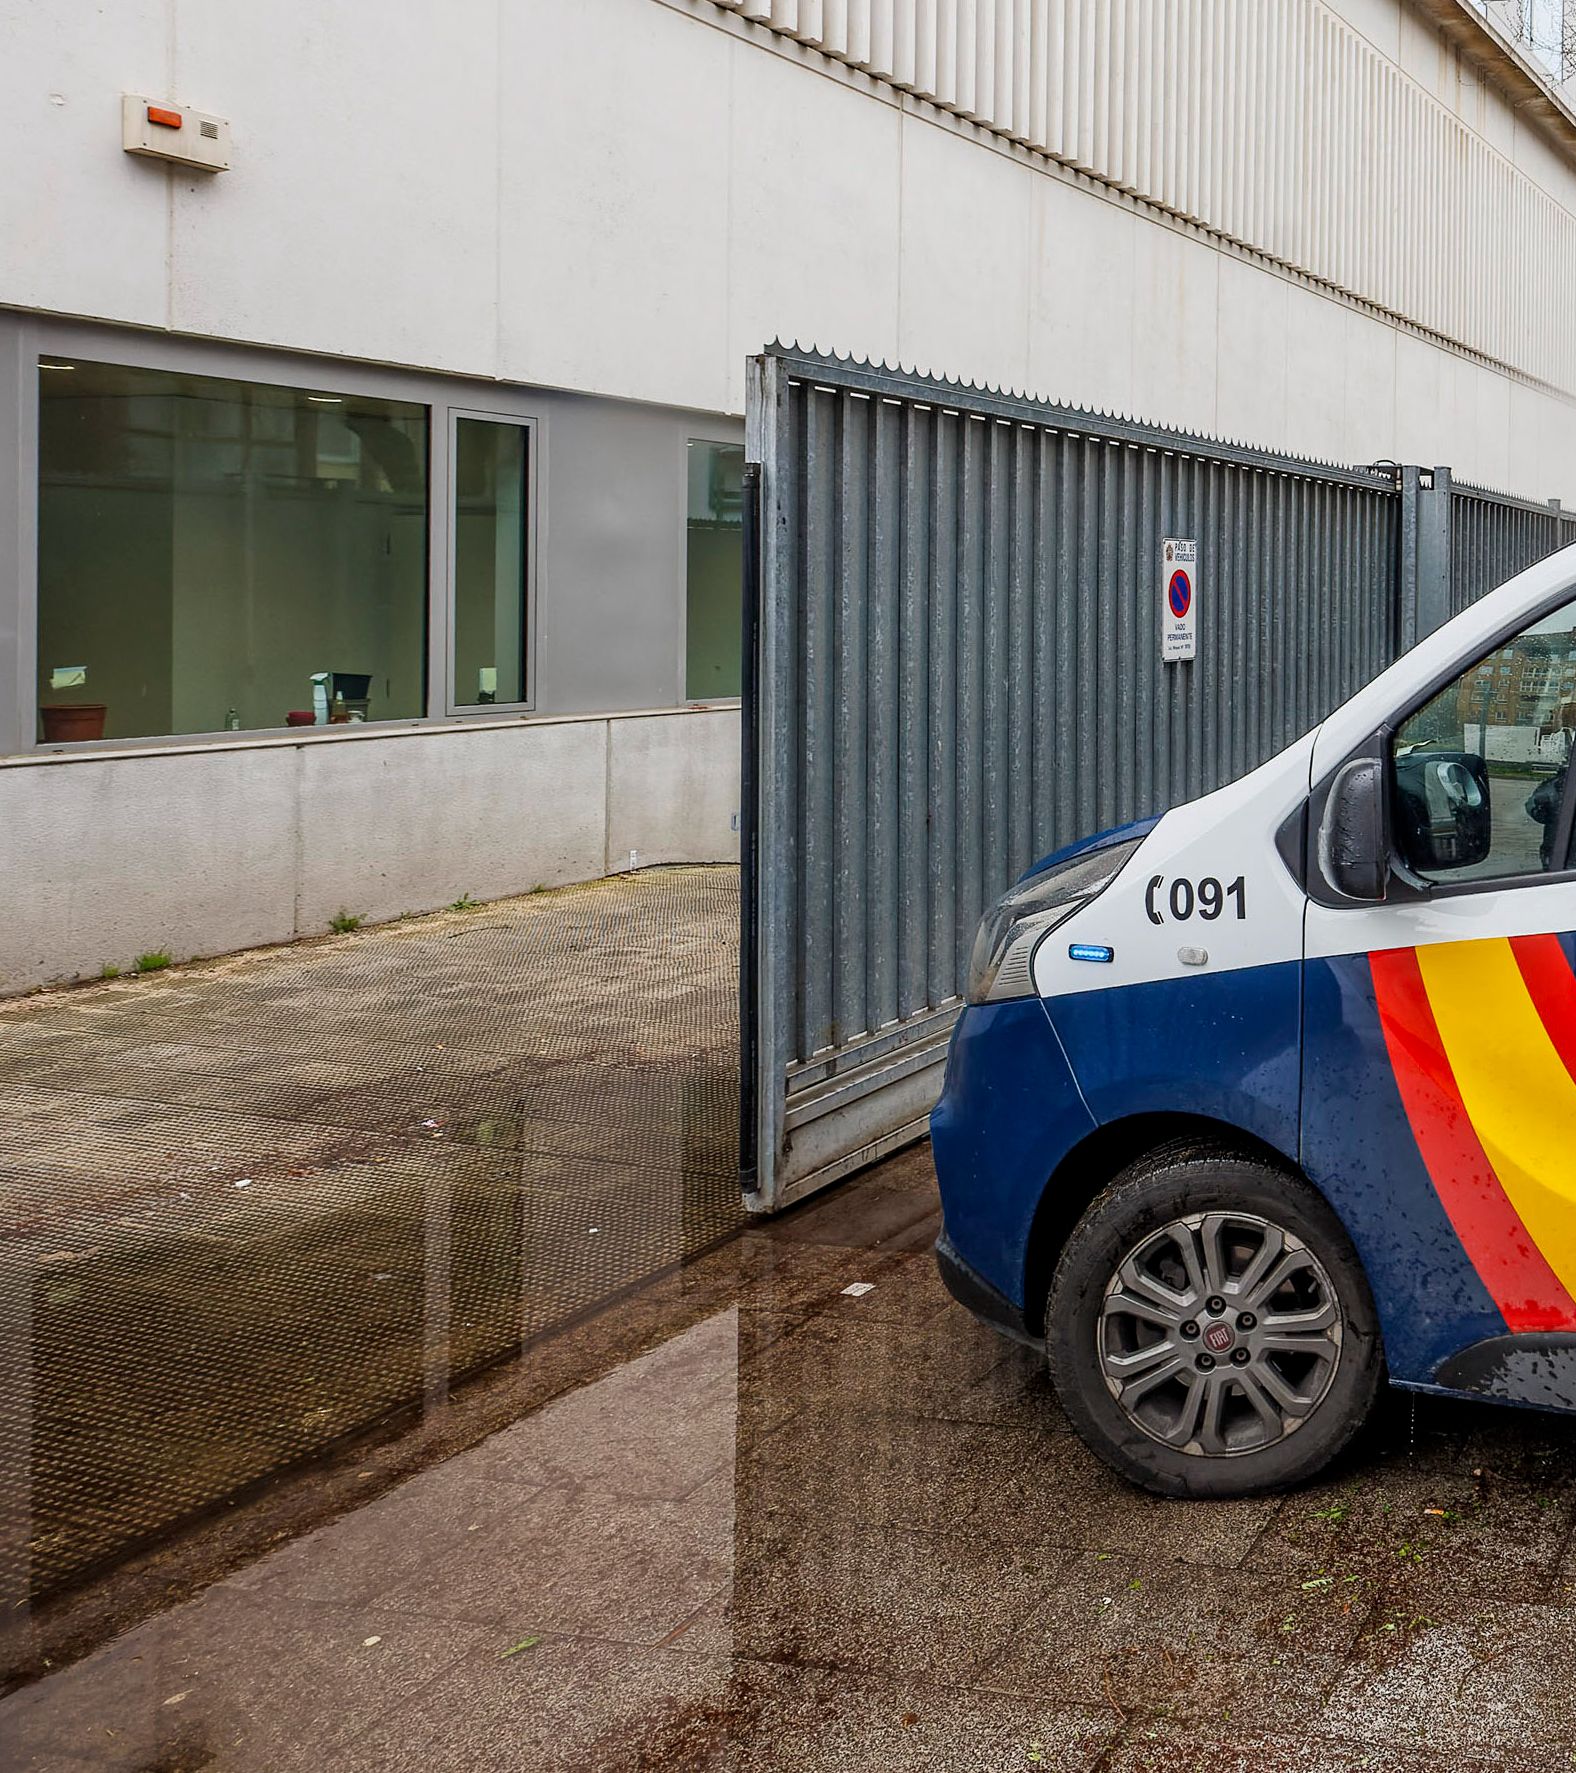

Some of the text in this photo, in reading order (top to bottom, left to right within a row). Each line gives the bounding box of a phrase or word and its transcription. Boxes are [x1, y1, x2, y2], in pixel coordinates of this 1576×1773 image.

[1174, 543, 1195, 553] PASO DE
[1174, 623, 1186, 631] VADO
[1167, 632, 1193, 642] PERMANENTE
[1169, 876, 1246, 921] 091
[1209, 1327, 1229, 1348] FIAT
